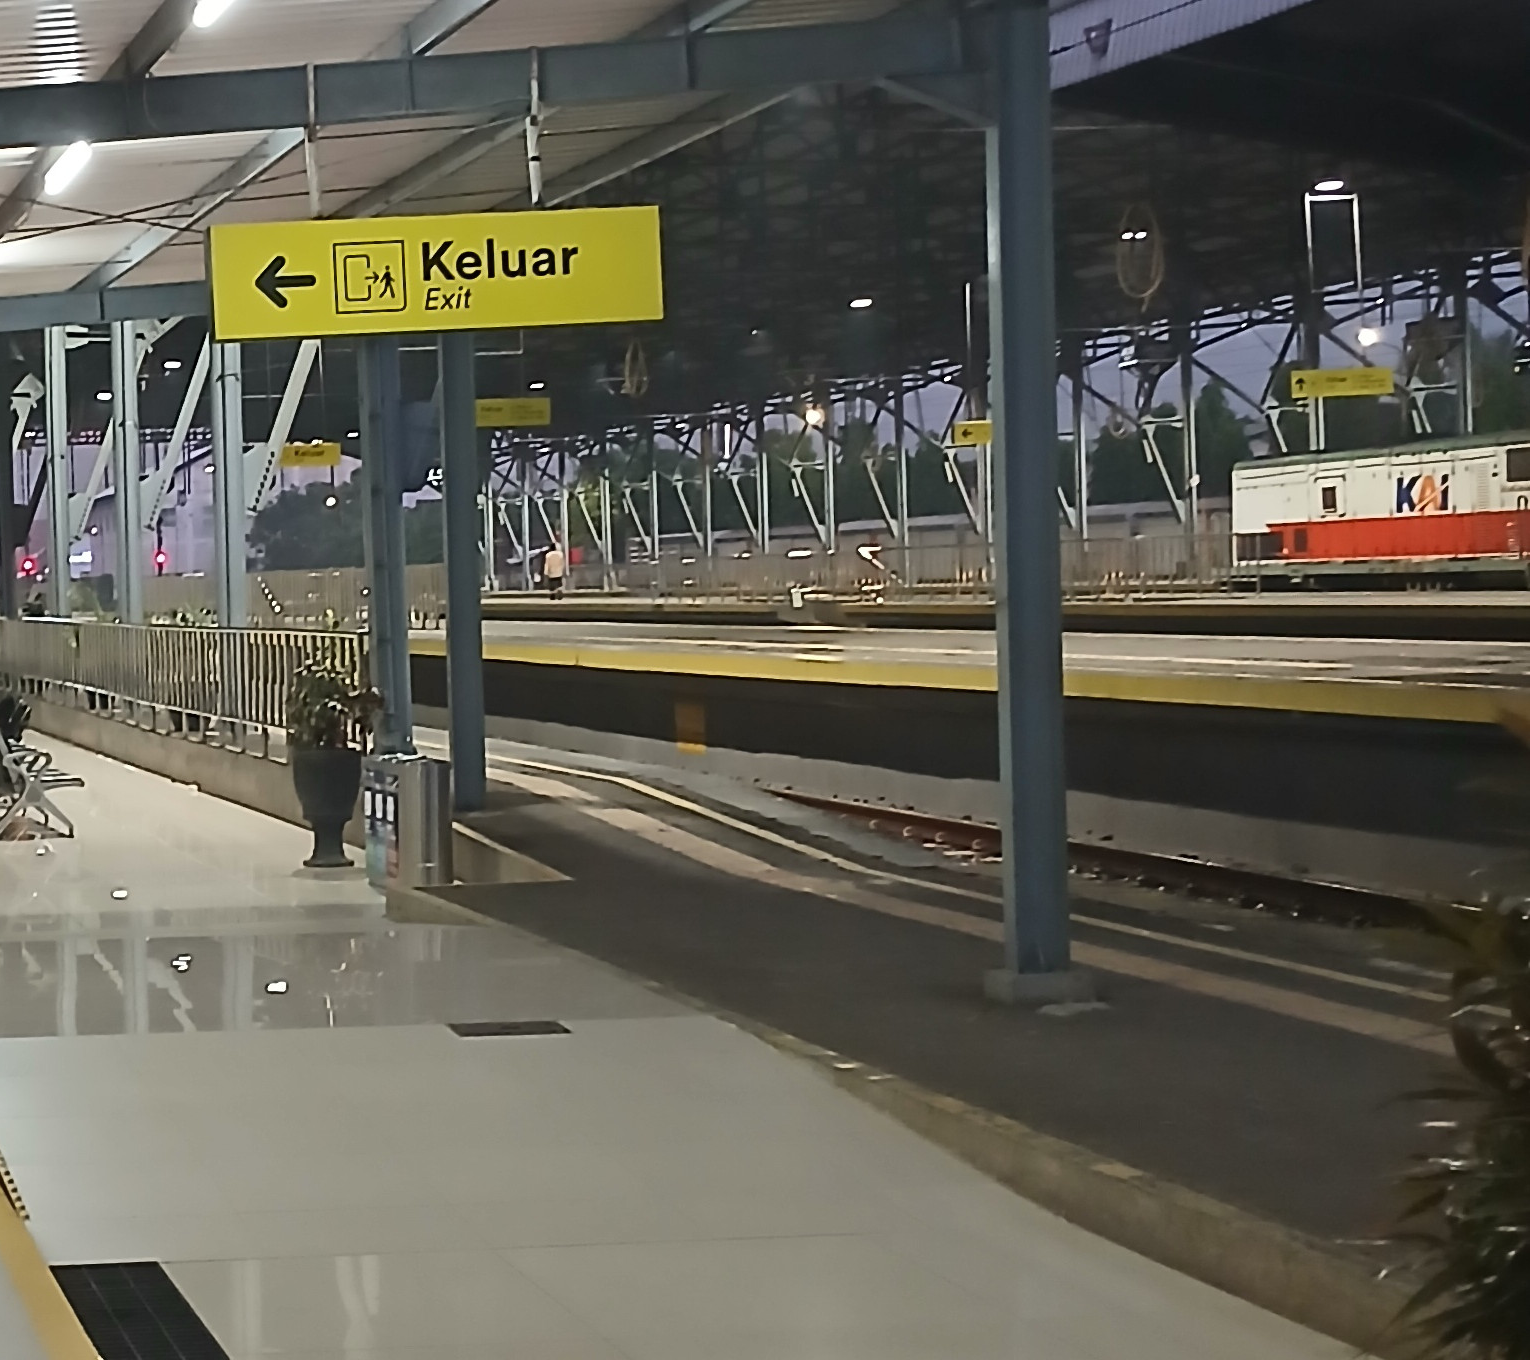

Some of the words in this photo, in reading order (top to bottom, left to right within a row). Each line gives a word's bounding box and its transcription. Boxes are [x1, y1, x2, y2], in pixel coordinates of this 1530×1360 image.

[421, 237, 579, 281] Keluar
[424, 285, 472, 311] Exit
[1396, 473, 1450, 514] KAI
